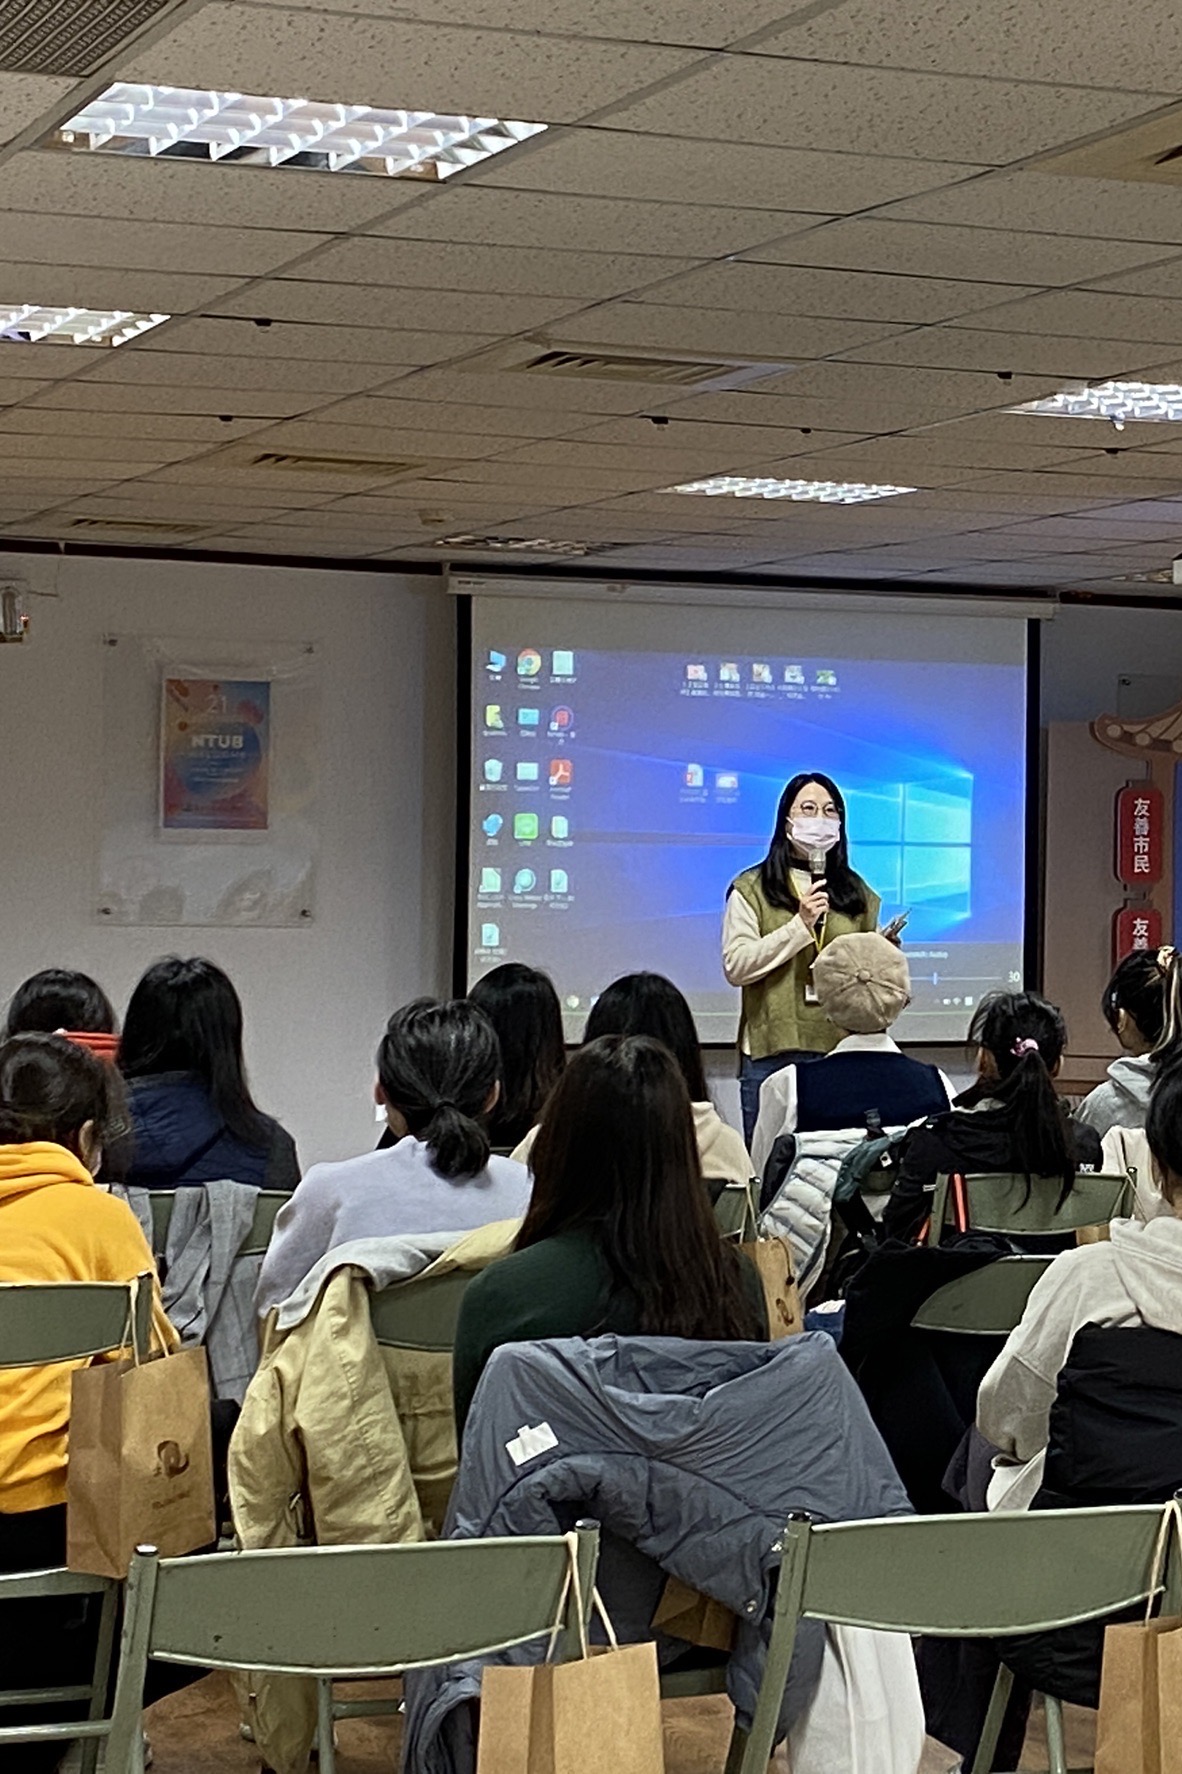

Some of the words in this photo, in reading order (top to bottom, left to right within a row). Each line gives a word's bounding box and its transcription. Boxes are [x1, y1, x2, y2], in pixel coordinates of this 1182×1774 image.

[191, 734, 244, 749] NTUB
[1133, 798, 1151, 874] 友善市民
